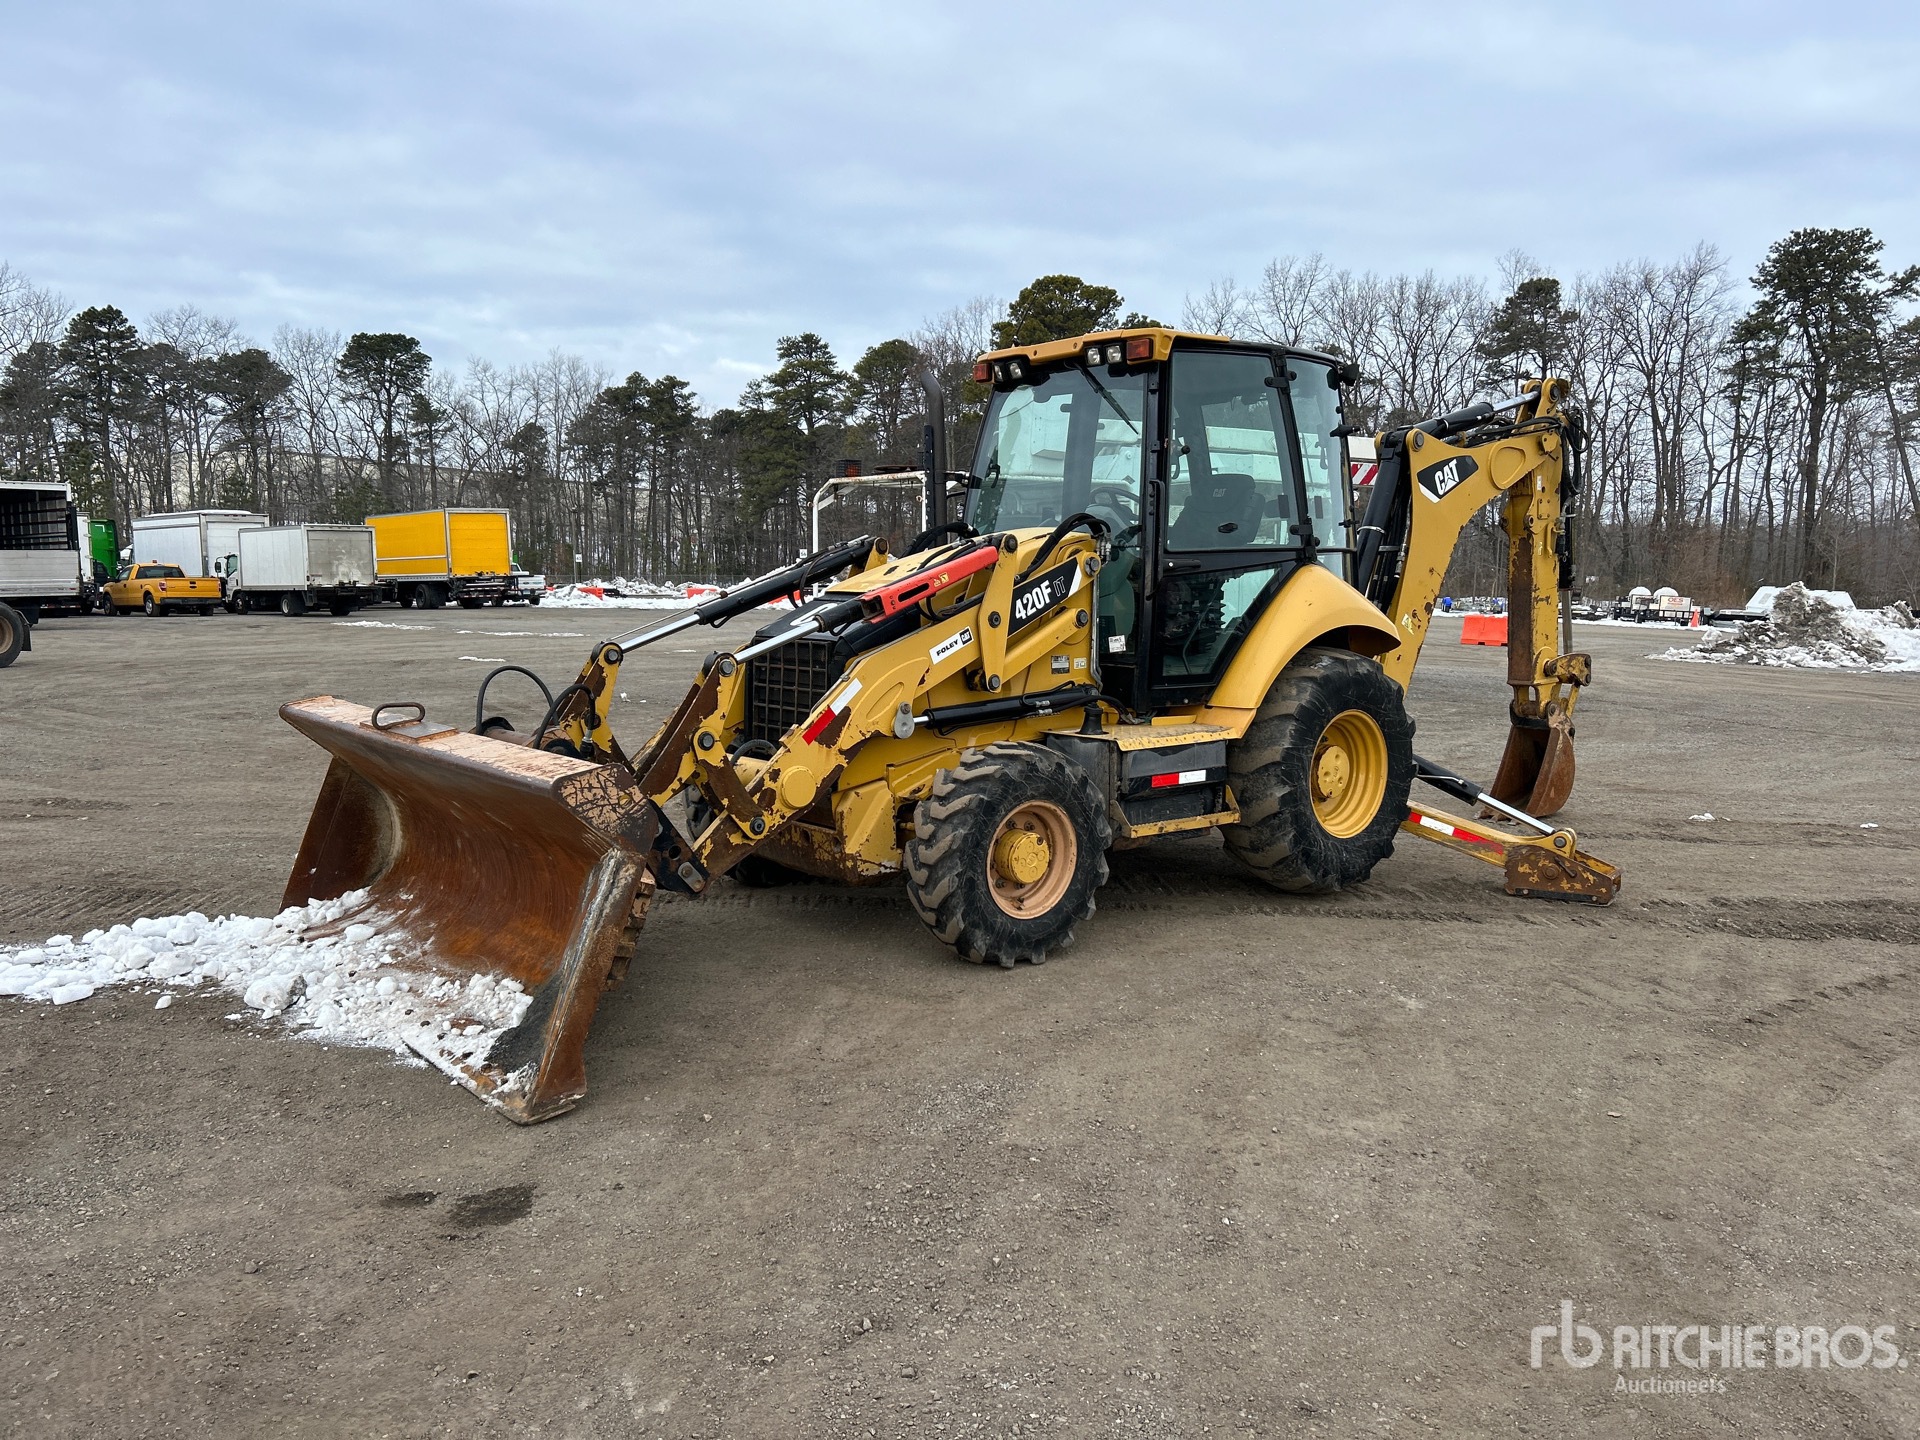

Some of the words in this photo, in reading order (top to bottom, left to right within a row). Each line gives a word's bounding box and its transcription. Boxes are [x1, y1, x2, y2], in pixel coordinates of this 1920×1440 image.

[1434, 459, 1459, 495] CAT
[1015, 580, 1051, 620] 420F
[936, 639, 958, 656] FOLEY
